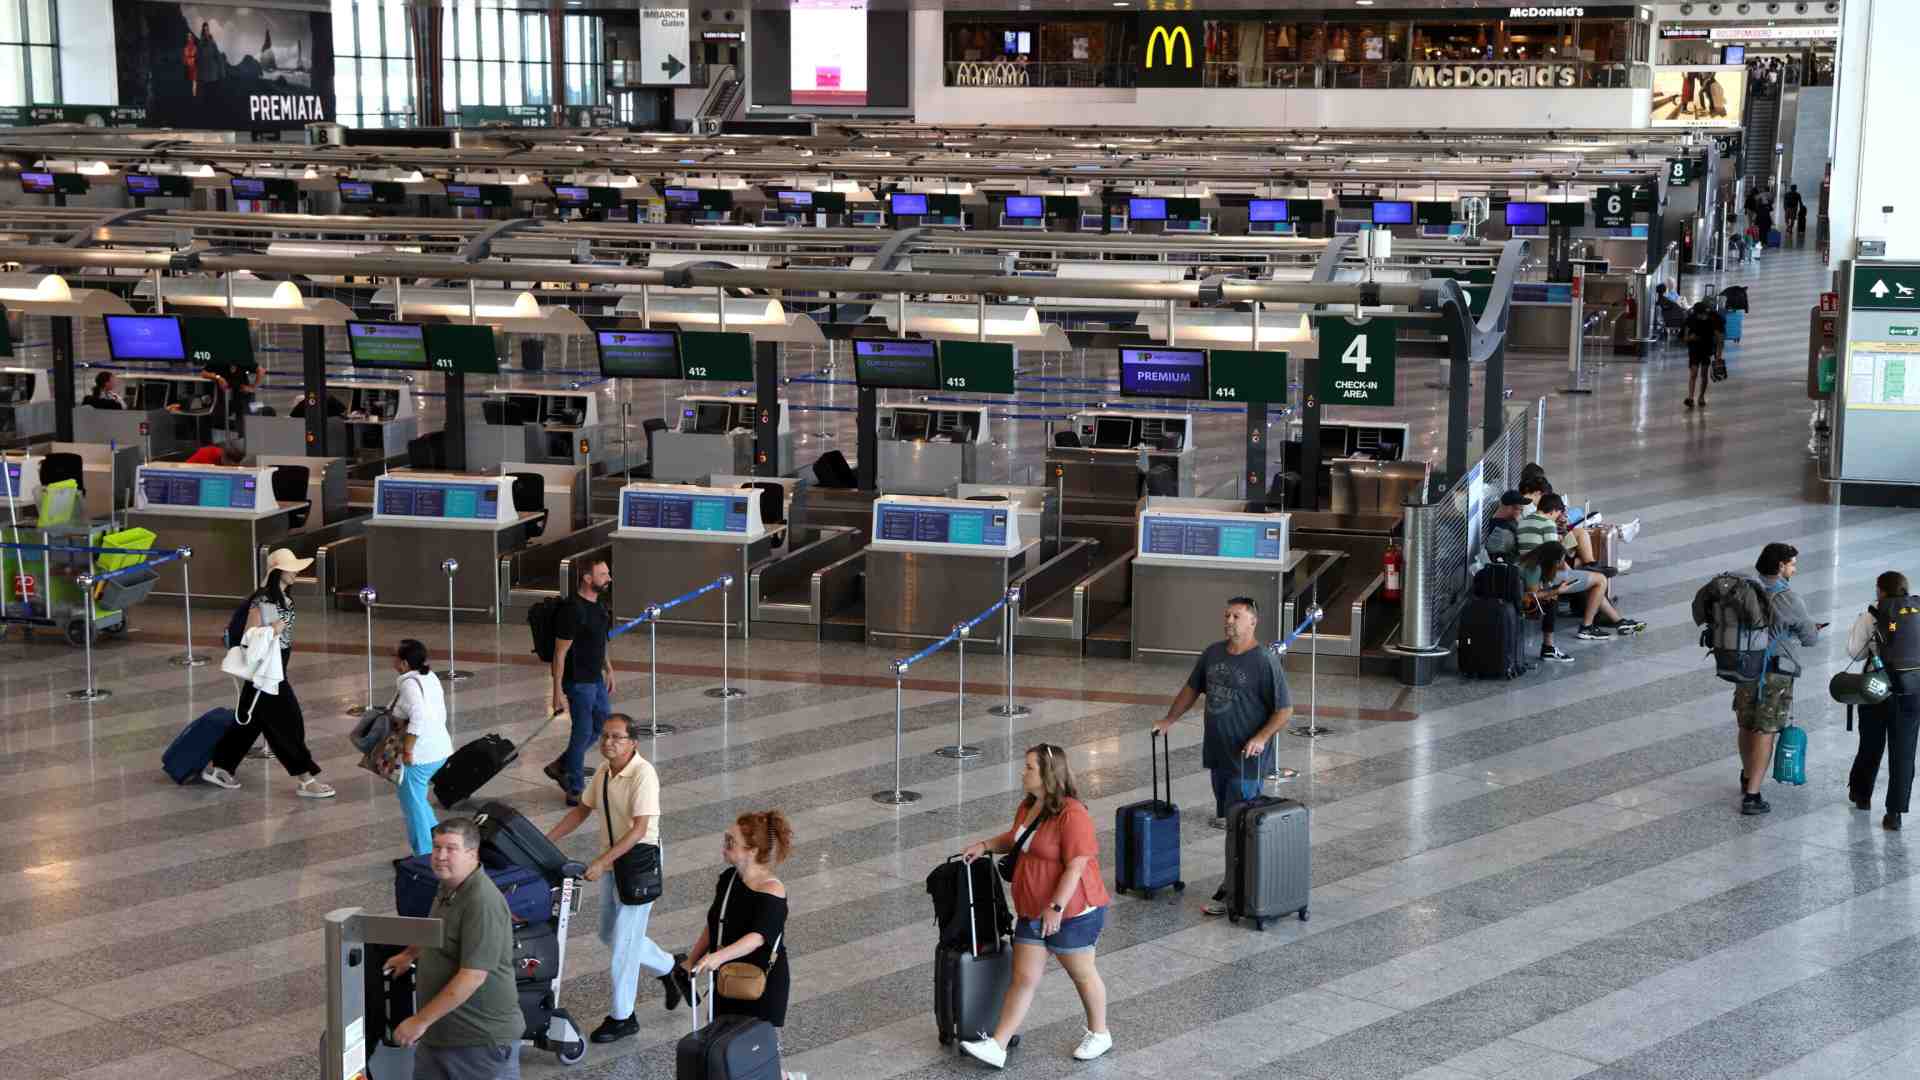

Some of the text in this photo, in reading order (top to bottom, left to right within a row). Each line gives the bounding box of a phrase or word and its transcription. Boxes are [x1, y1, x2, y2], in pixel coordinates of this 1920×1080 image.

[1509, 7, 1584, 18] McDonald's
[1410, 64, 1577, 87] McDonald's
[249, 95, 324, 120] PREMIATA
[319, 129, 329, 144] 8
[1673, 163, 1684, 176] 8
[1607, 195, 1621, 214] 6
[193, 351, 211, 360] 410
[1341, 334, 1372, 373] 4
[436, 359, 453, 368] 411
[688, 367, 707, 376] 412
[1137, 371, 1191, 382] PREMIUM
[946, 377, 966, 387] 413
[1335, 380, 1378, 389] CHECK-IN
[1215, 387, 1236, 397] 414
[1343, 390, 1368, 398] AREA
